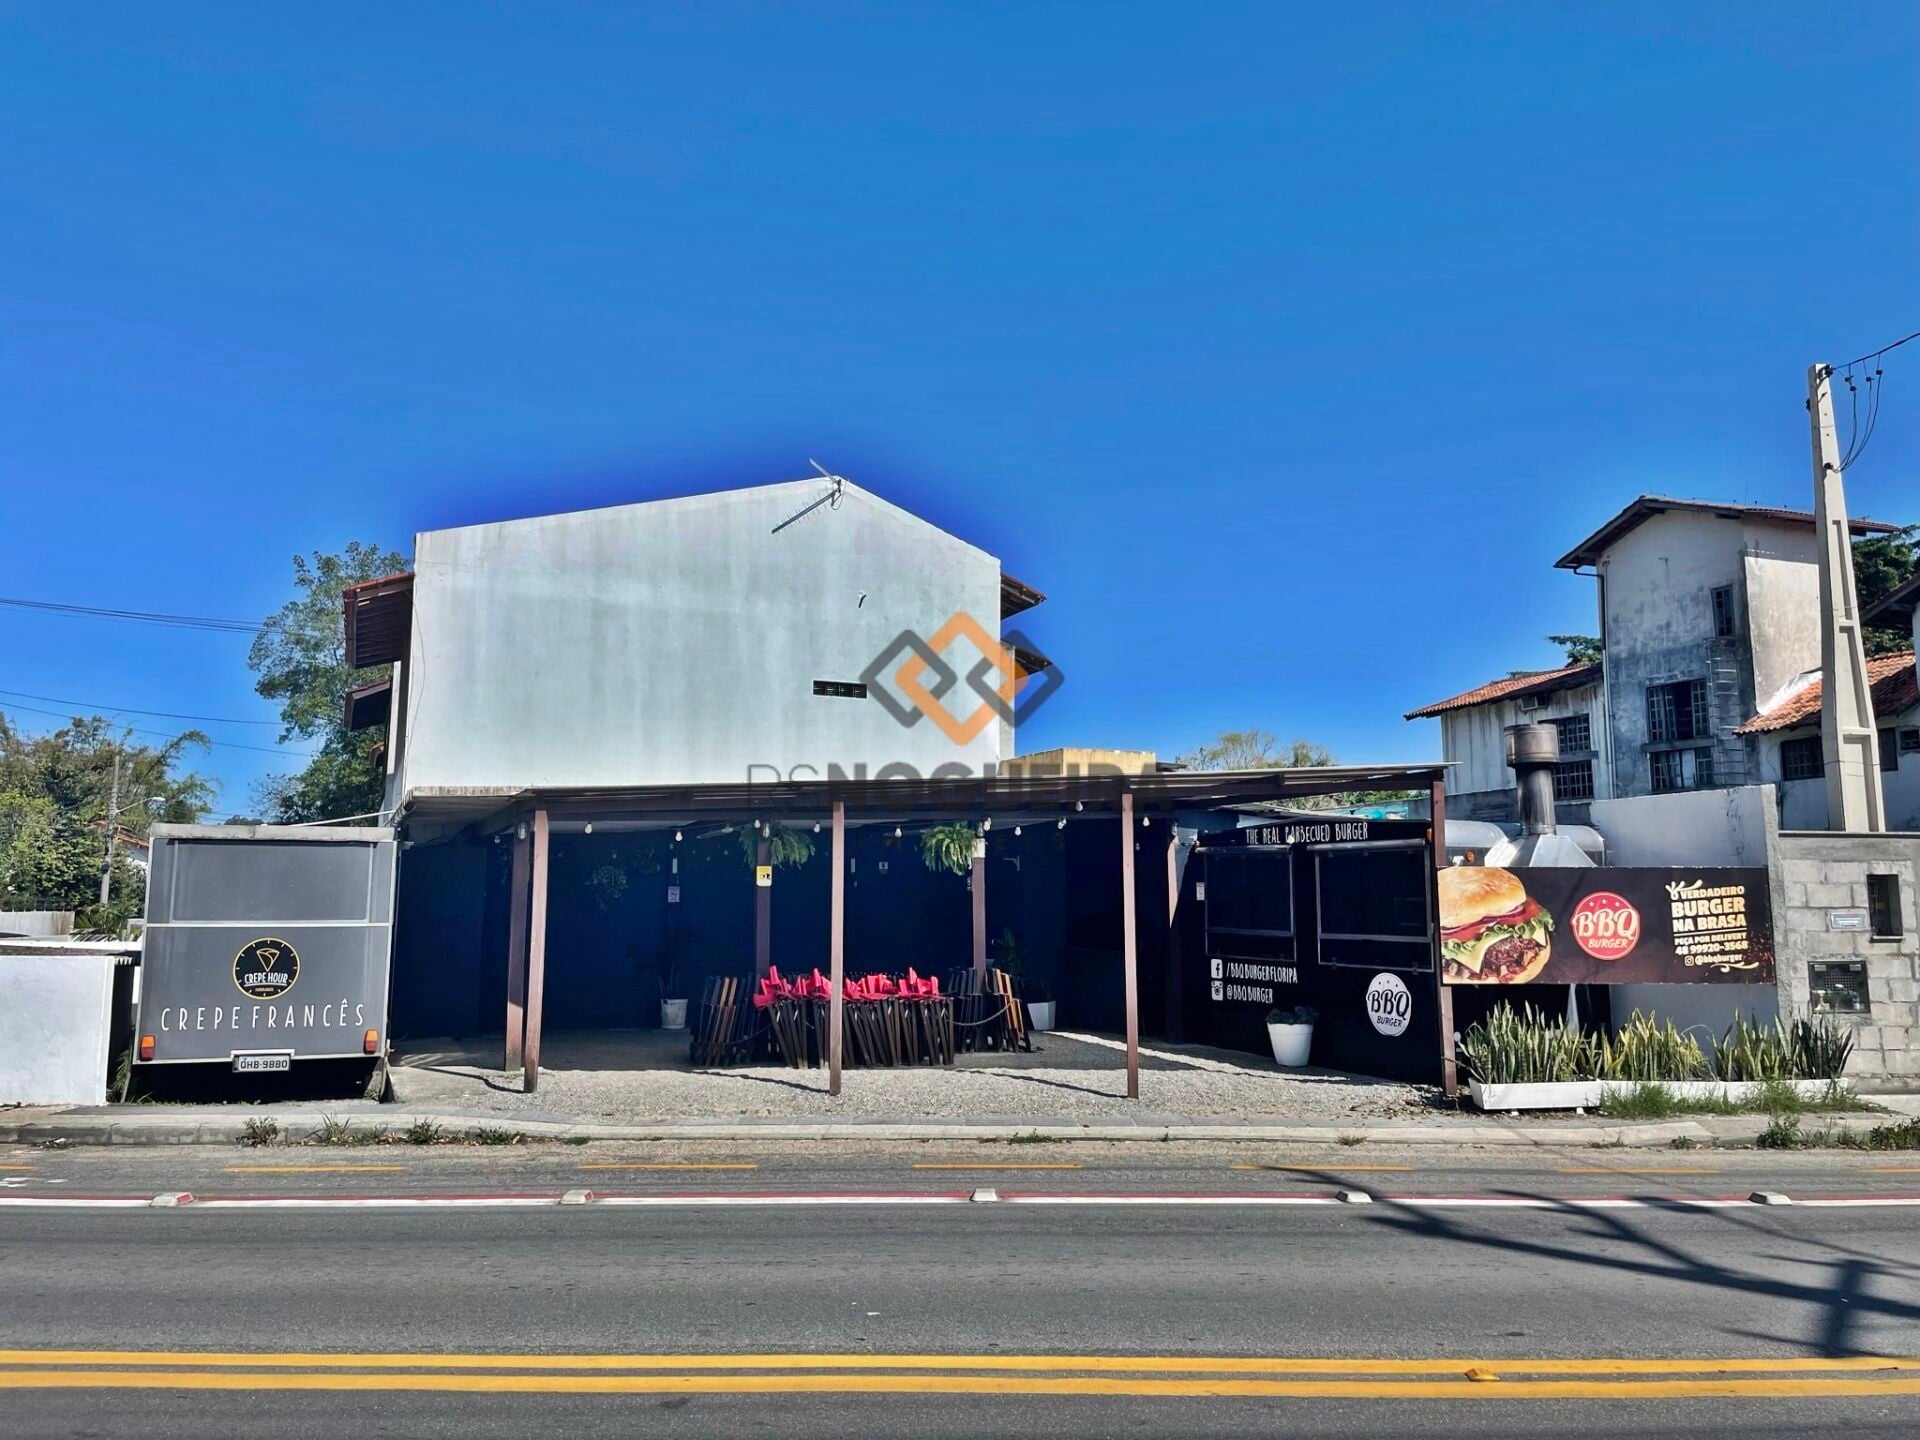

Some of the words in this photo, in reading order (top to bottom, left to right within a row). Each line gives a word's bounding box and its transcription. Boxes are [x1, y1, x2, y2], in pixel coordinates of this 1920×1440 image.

[1246, 829, 1259, 844] THE
[1262, 827, 1281, 844] REAL
[1335, 822, 1369, 841] BURGER
[1680, 886, 1745, 900] VERDADEIRO
[1671, 897, 1746, 918] BURGER
[1572, 907, 1639, 941] BBQ
[1672, 918, 1695, 933] NA
[1697, 914, 1747, 931] BRASA
[1587, 938, 1628, 949] BURGER
[1695, 935, 1711, 944] POR
[1711, 932, 1748, 942] DELIVERY
[1675, 945, 1689, 955] 48
[244, 972, 267, 984] CREPE
[267, 972, 289, 984] HOUR
[1367, 990, 1411, 1019] BBQ
[161, 1006, 241, 1031] CREPE
[252, 998, 364, 1028] FRANCÊS
[1376, 1016, 1403, 1028] BURGER
